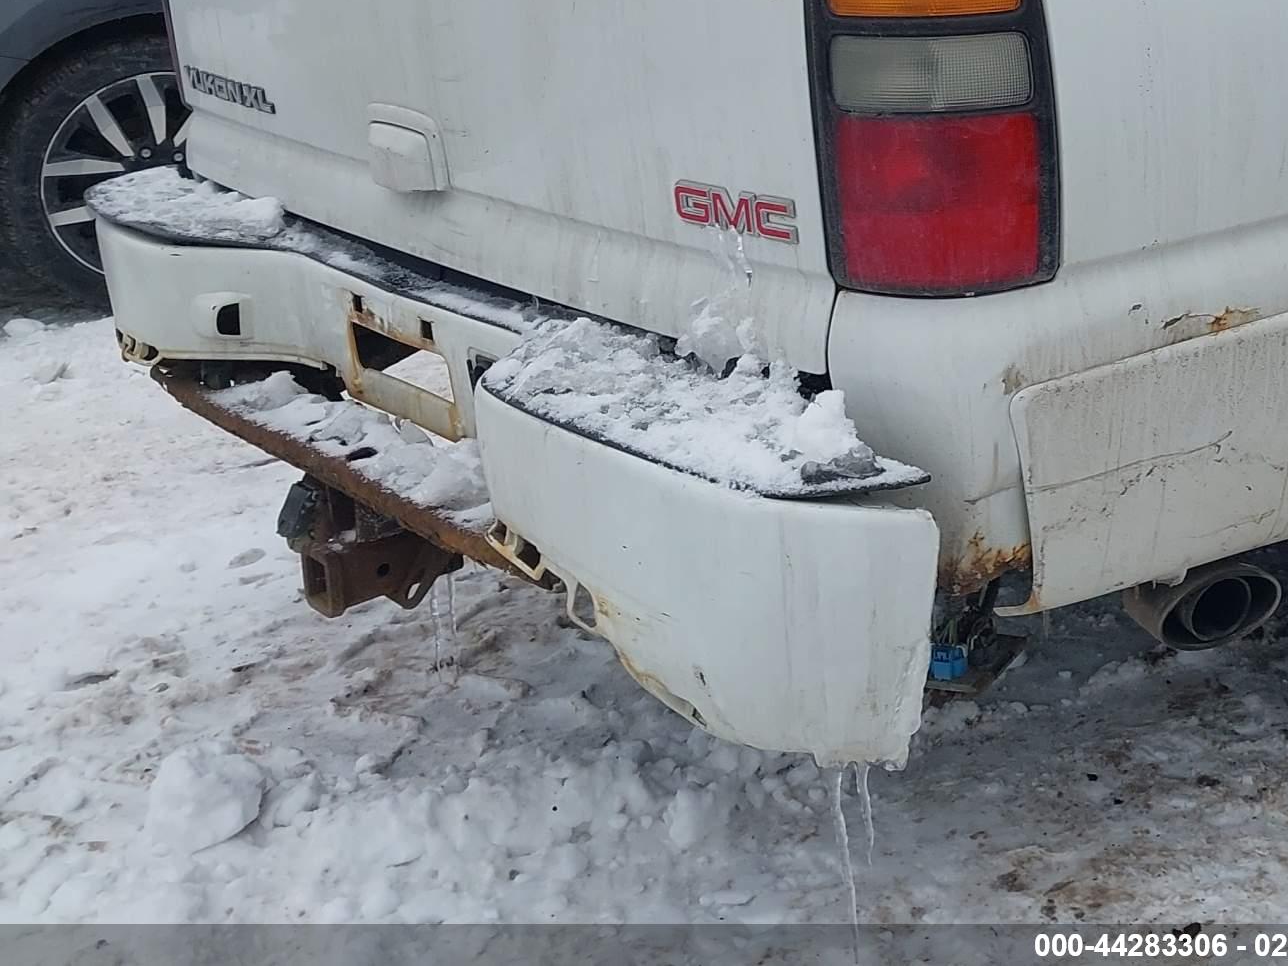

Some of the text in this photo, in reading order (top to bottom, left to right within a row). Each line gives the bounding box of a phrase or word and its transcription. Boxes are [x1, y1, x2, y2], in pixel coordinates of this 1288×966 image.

[184, 65, 276, 114] YUKON XL
[674, 179, 800, 245] GMC
